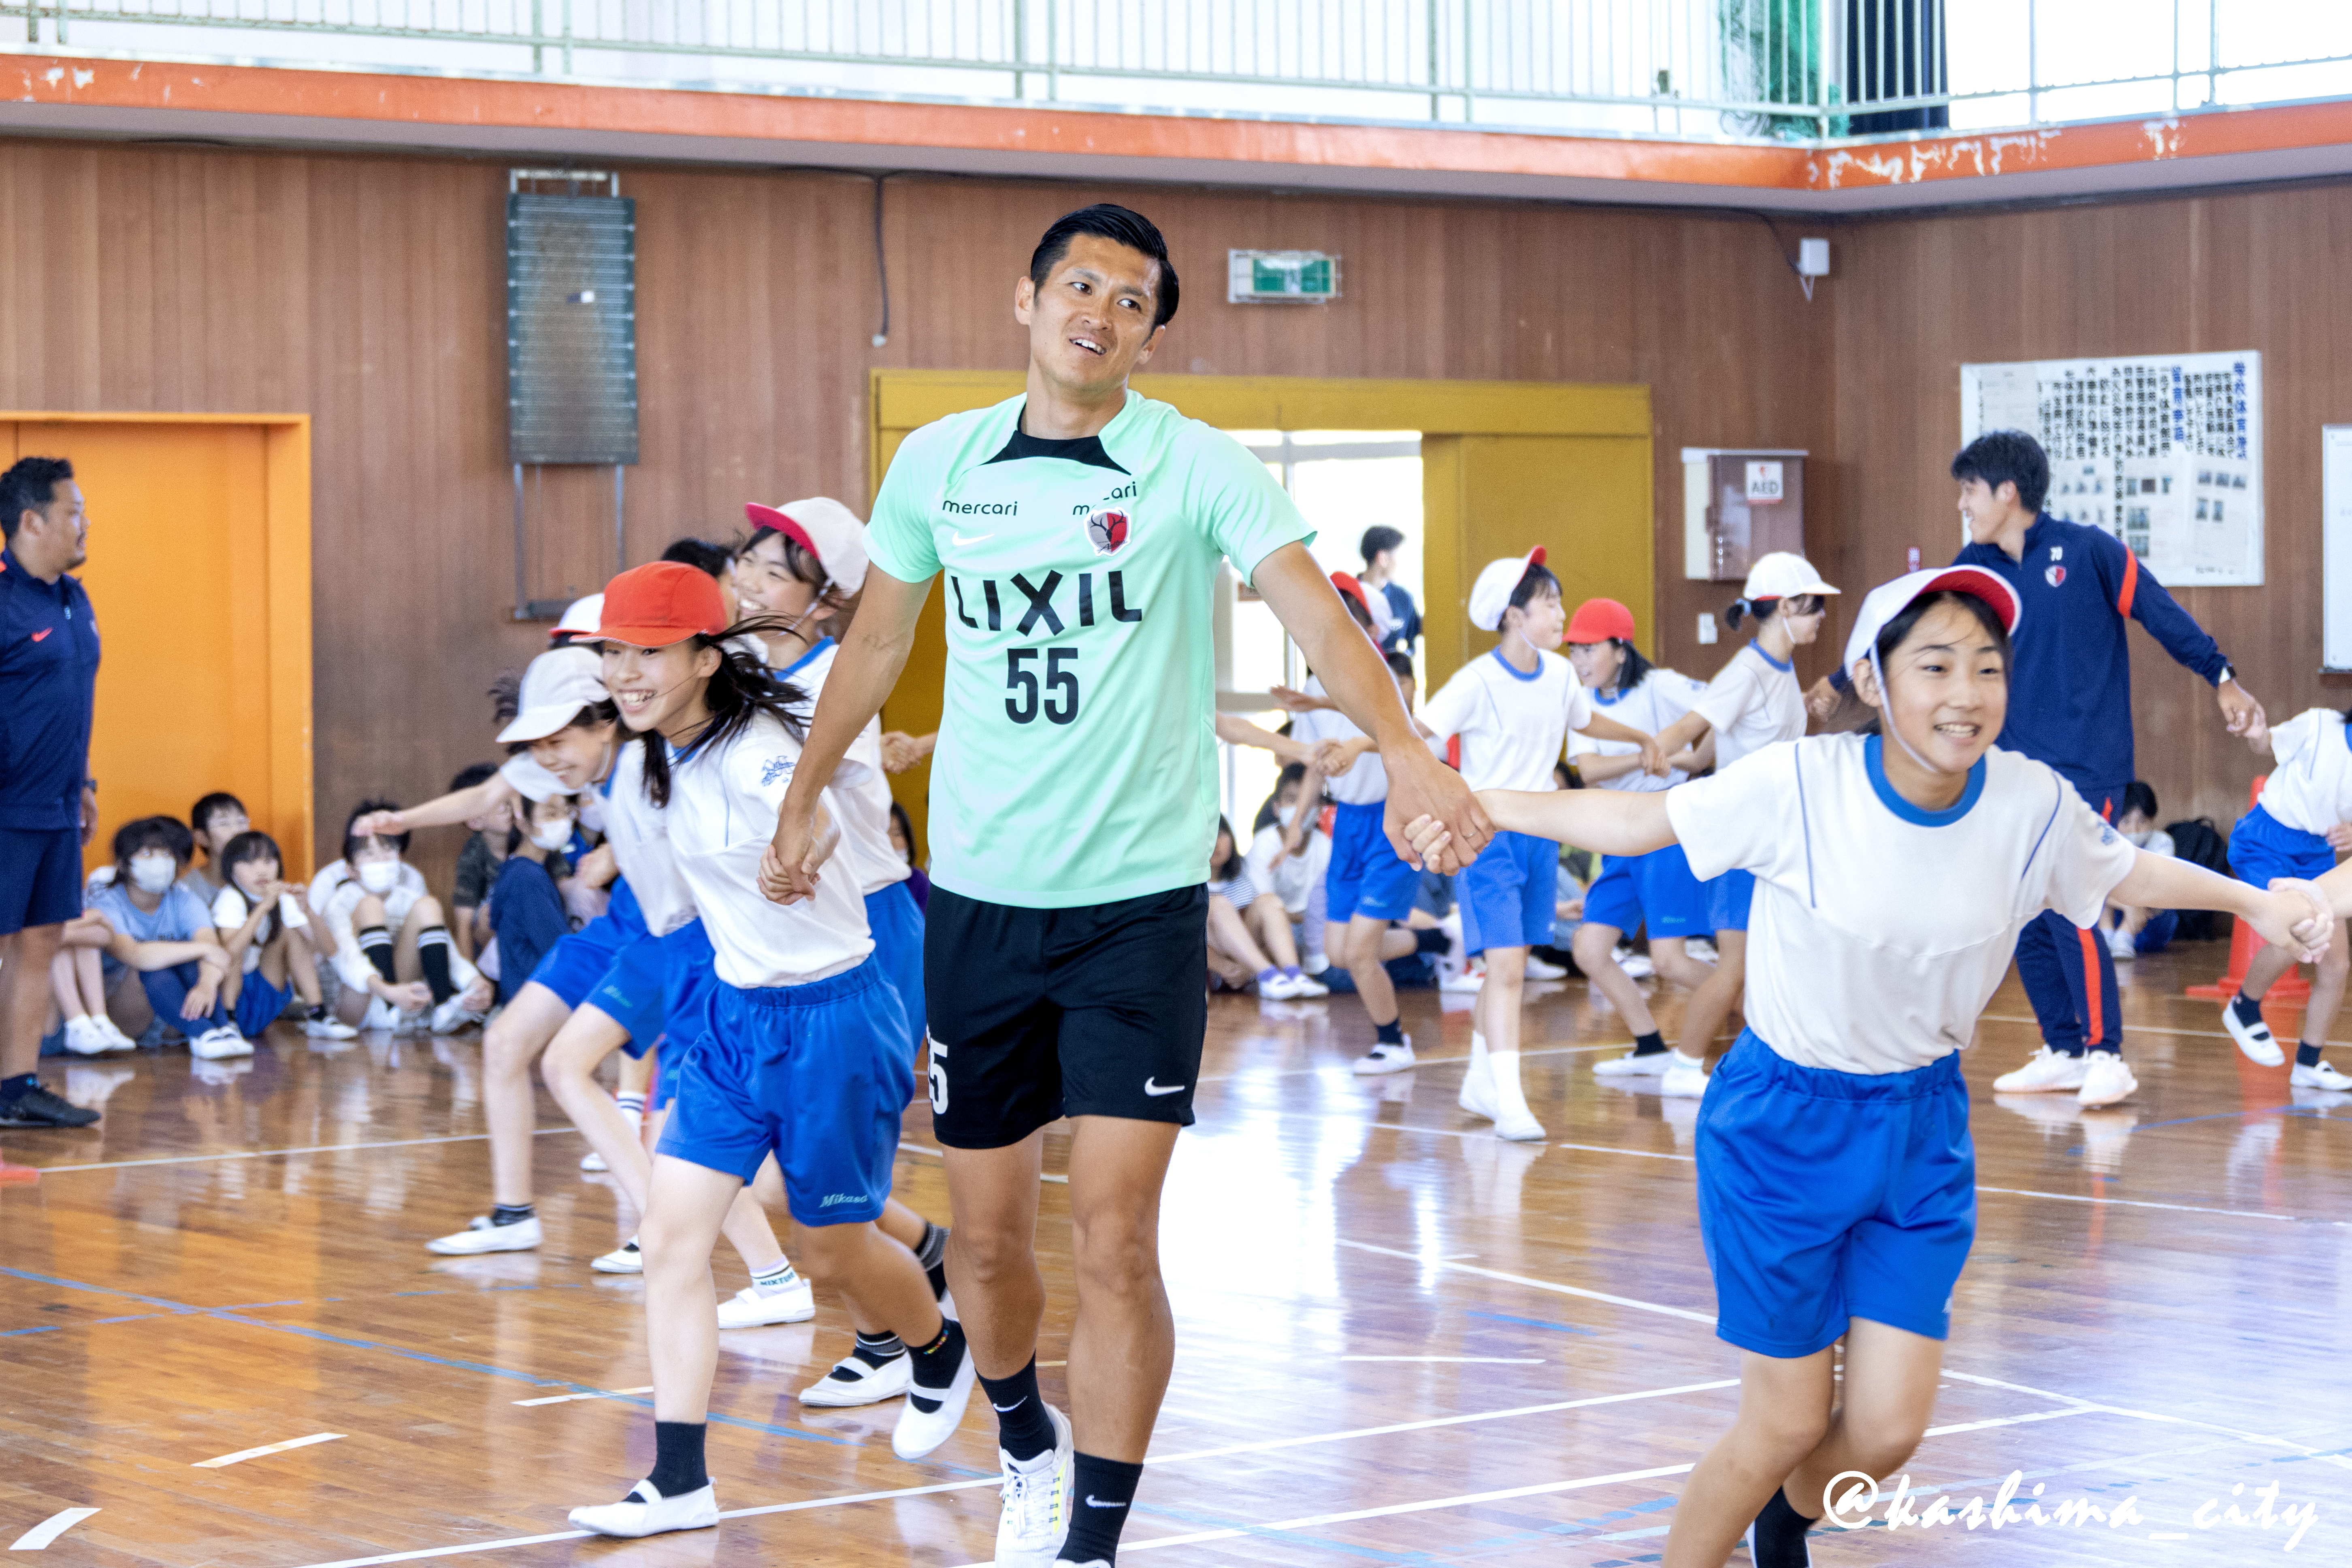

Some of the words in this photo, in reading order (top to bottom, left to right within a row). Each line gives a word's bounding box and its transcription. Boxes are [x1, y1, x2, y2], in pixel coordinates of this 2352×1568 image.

[1751, 480, 1779, 495] AED
[942, 500, 1018, 516] mercari
[2050, 546, 2063, 561] 70
[950, 569, 1142, 637] LIXIL
[1005, 648, 1078, 725] 55
